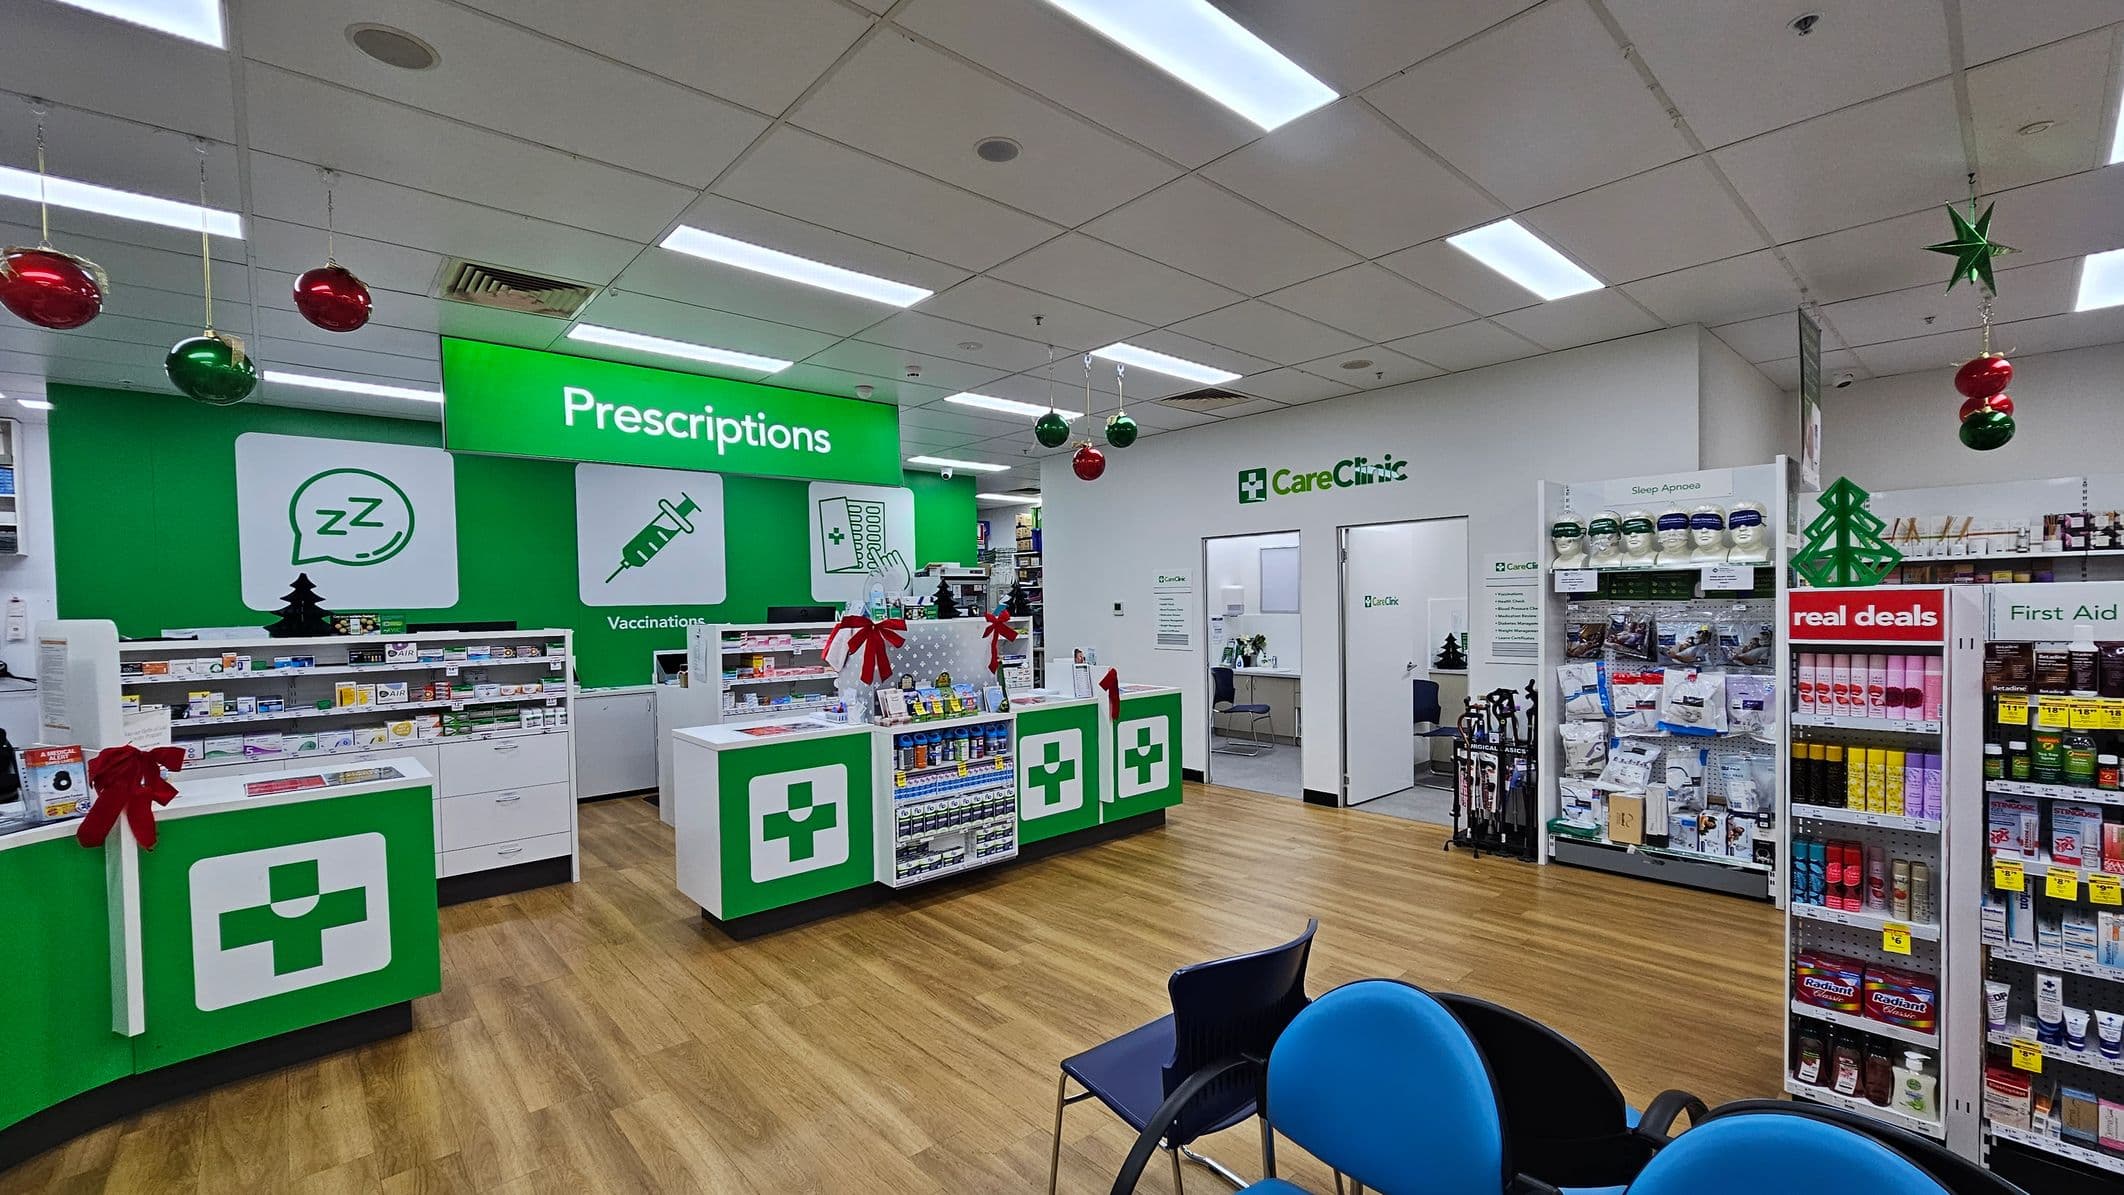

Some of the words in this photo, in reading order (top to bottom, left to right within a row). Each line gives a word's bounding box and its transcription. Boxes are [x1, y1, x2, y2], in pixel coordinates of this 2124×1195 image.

[563, 386, 832, 456] Prescriptions
[1271, 453, 1408, 496] CareClinic
[1631, 486, 1659, 495] Sleep
[1661, 482, 1702, 494] Apnoea
[1372, 596, 1399, 606] CareClinic
[1793, 604, 1847, 626] real
[1854, 604, 1938, 627] deals
[2010, 605, 2064, 621] First
[2072, 604, 2117, 621] Aid
[607, 614, 705, 631] Vaccinations
[397, 649, 414, 658] AIR
[389, 688, 405, 697] AIR
[46, 748, 76, 757] MEDICAL
[1990, 800, 2035, 811] STINGOSE
[2053, 806, 2101, 819] STINGOSE
[1891, 936, 1902, 945] $6
[1804, 977, 1854, 997] Radiant
[1813, 989, 1845, 1003] Classic
[1873, 993, 1927, 1014] Radiant
[1883, 1004, 1917, 1020] Classic
